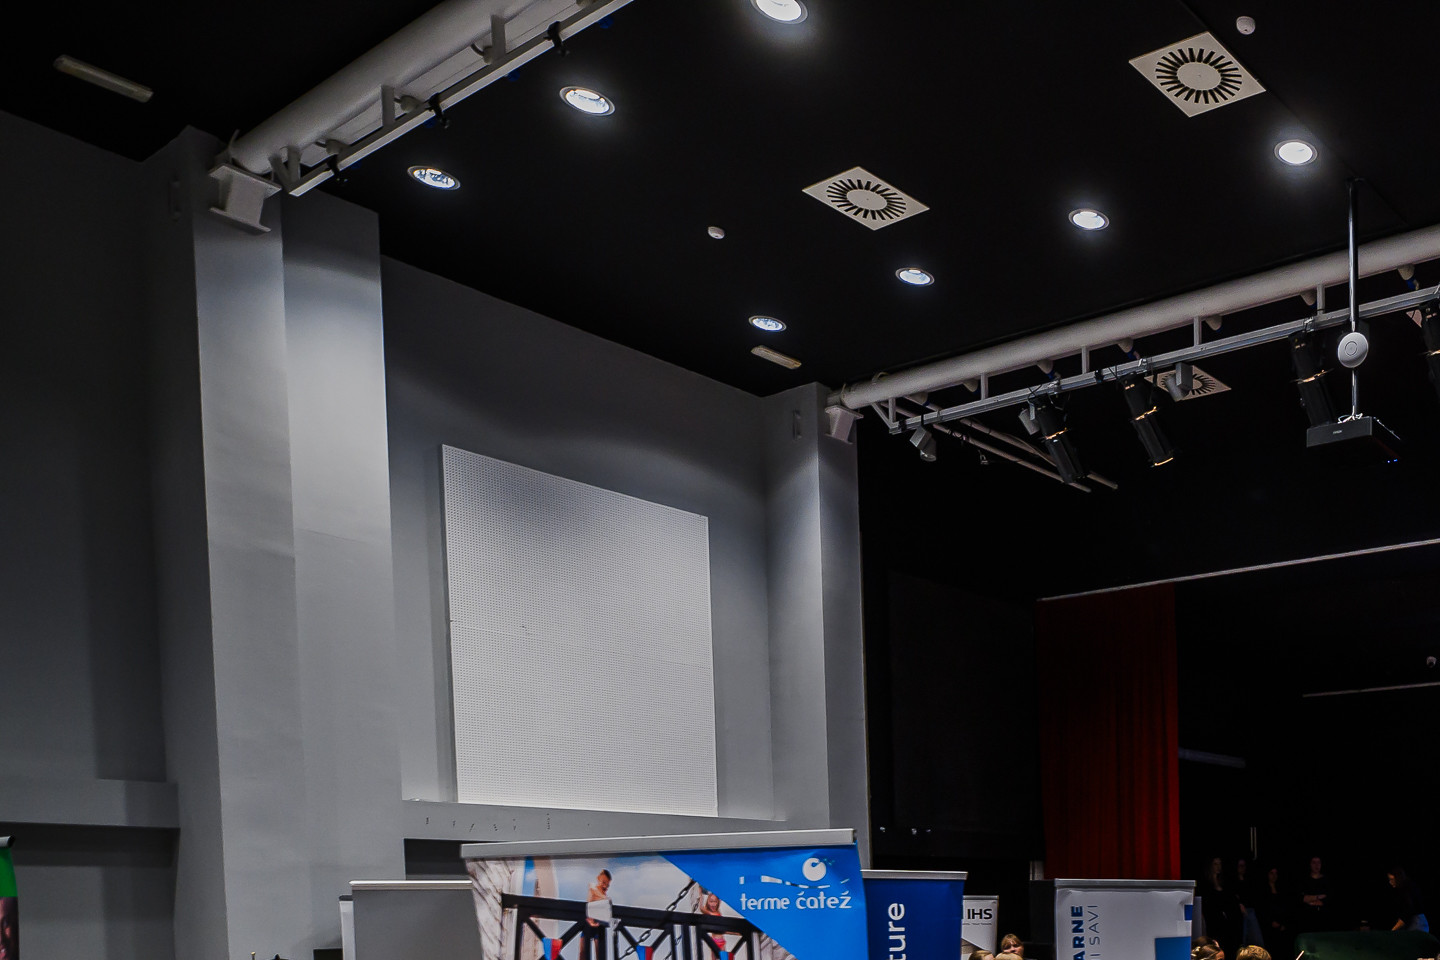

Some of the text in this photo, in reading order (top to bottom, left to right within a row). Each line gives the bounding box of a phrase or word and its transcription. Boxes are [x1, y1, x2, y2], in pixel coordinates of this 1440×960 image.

[740, 893, 791, 911] terme
[967, 908, 993, 920] IHS
[1087, 905, 1101, 946] SAVI
